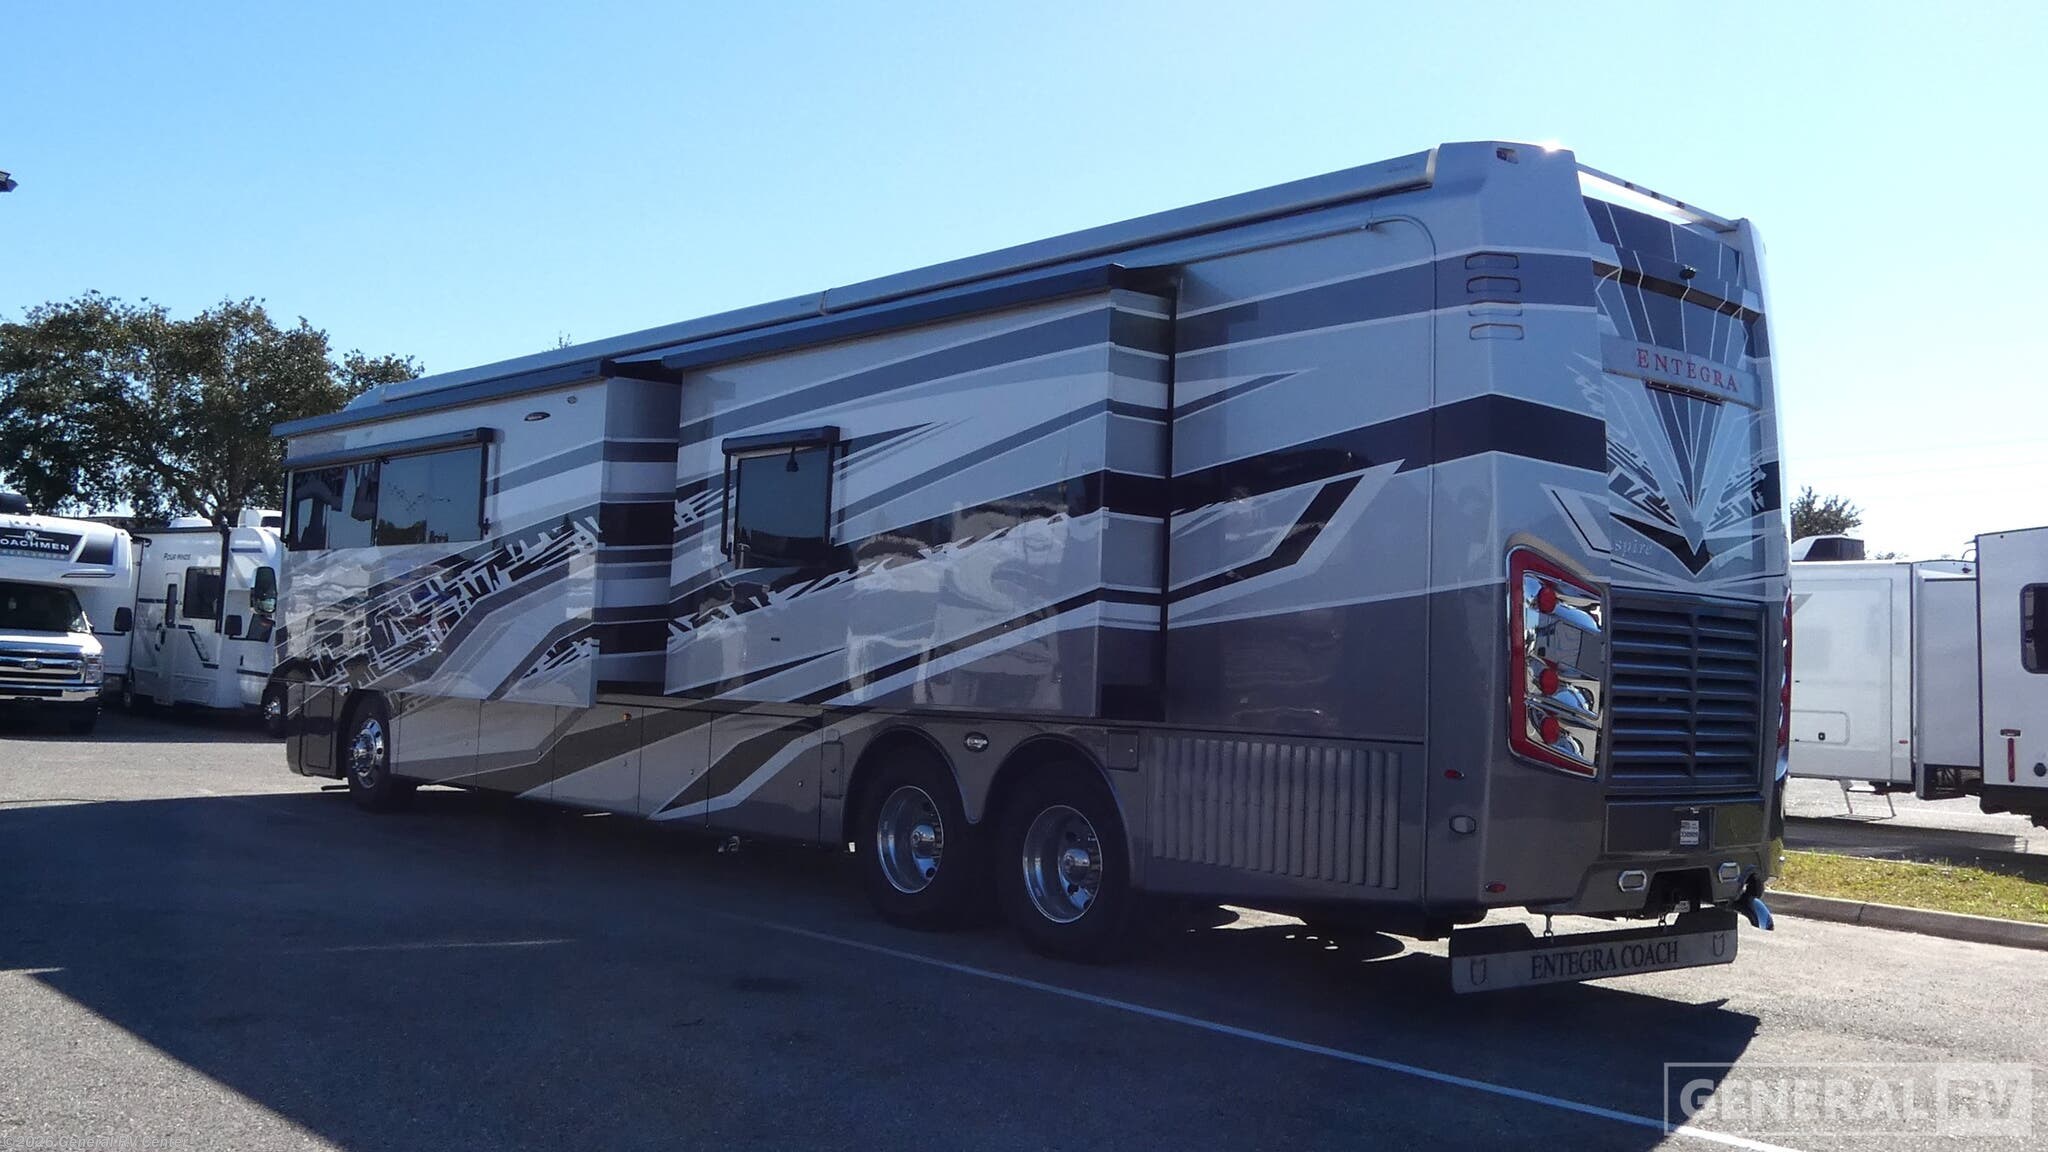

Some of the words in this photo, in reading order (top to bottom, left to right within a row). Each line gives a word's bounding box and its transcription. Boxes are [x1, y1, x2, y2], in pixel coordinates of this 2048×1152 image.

[1635, 347, 1739, 393] ENTEGRA
[1530, 950, 1617, 980] ENTEGRA
[1621, 940, 1679, 969] COACH
